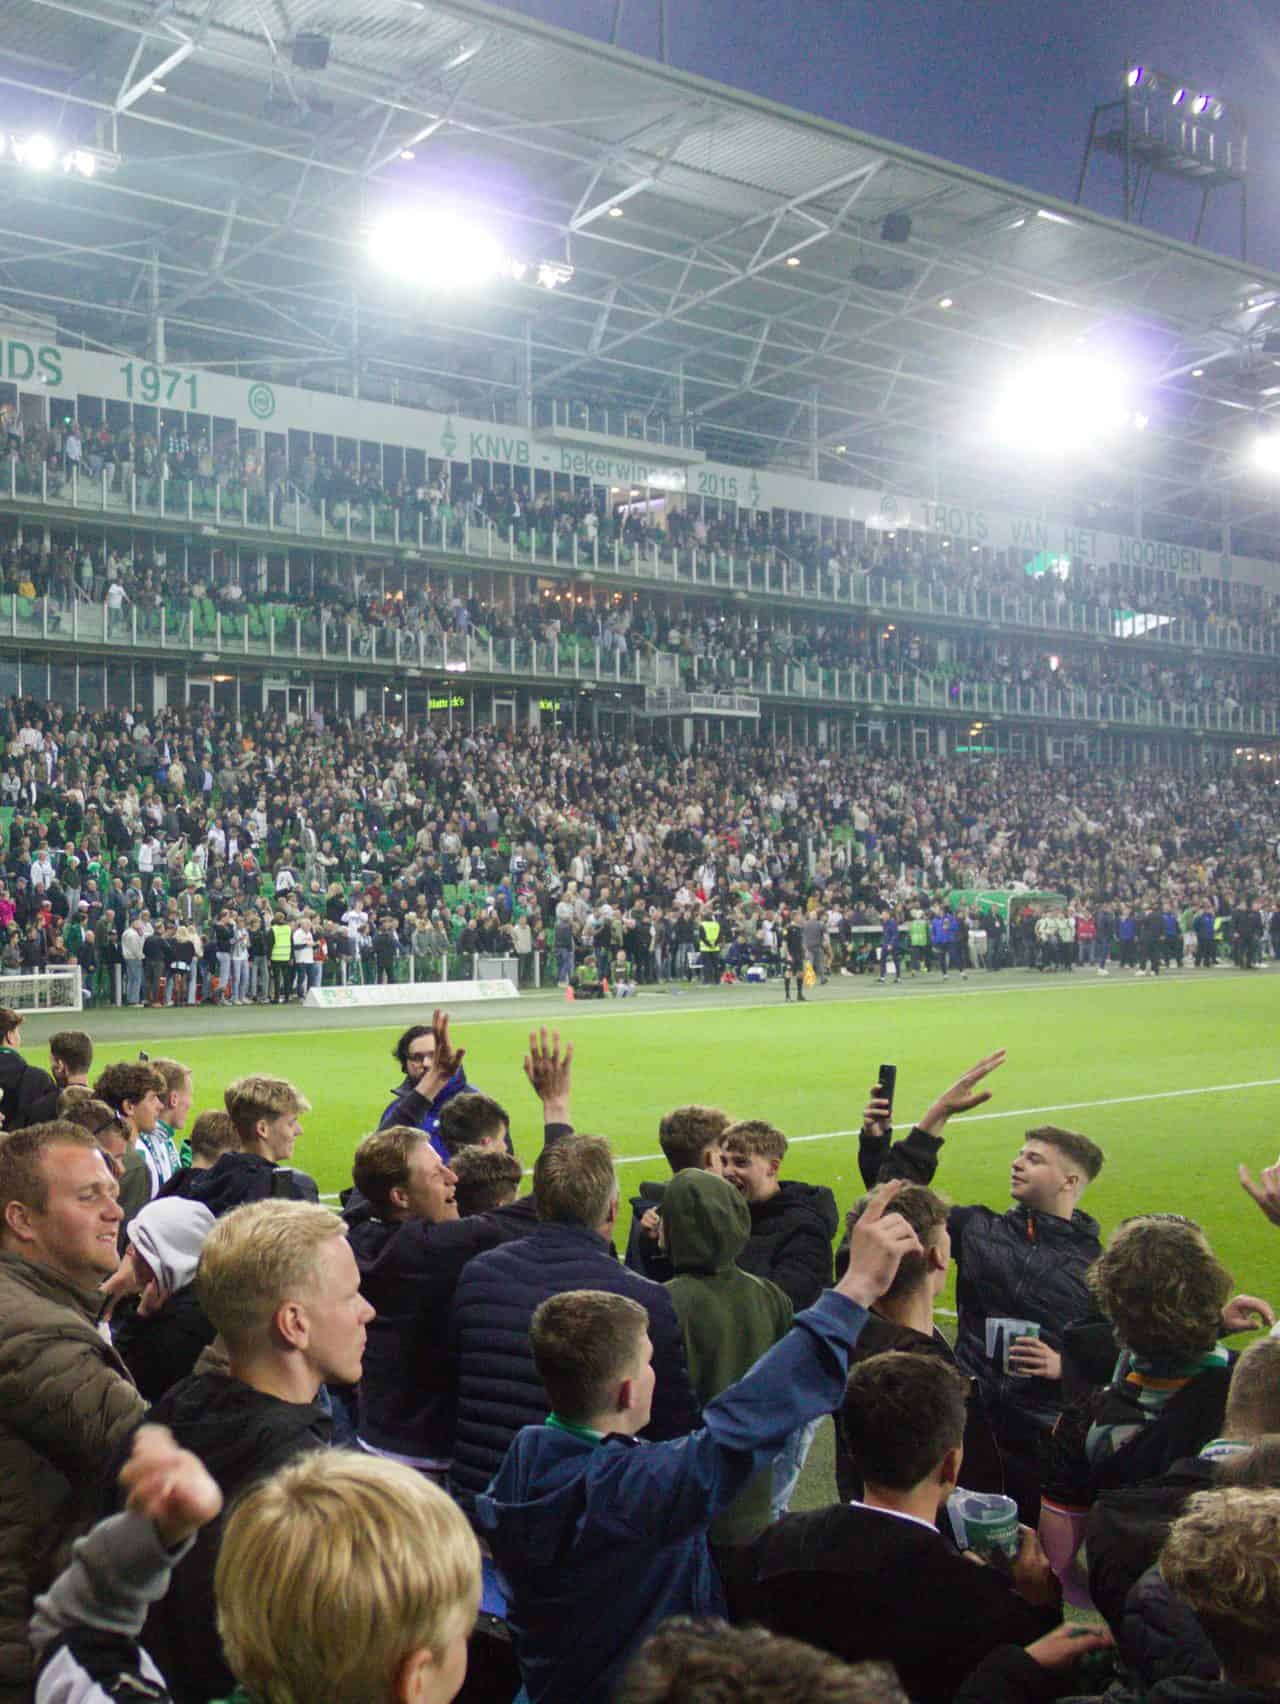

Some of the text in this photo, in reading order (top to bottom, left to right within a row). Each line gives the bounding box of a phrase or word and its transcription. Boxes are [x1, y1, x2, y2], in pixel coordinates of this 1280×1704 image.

[120, 361, 198, 409] 1971
[470, 432, 529, 462] KNVB
[697, 471, 737, 495] 2015
[922, 503, 1202, 574] TROTS VAN HET NOORDEN
